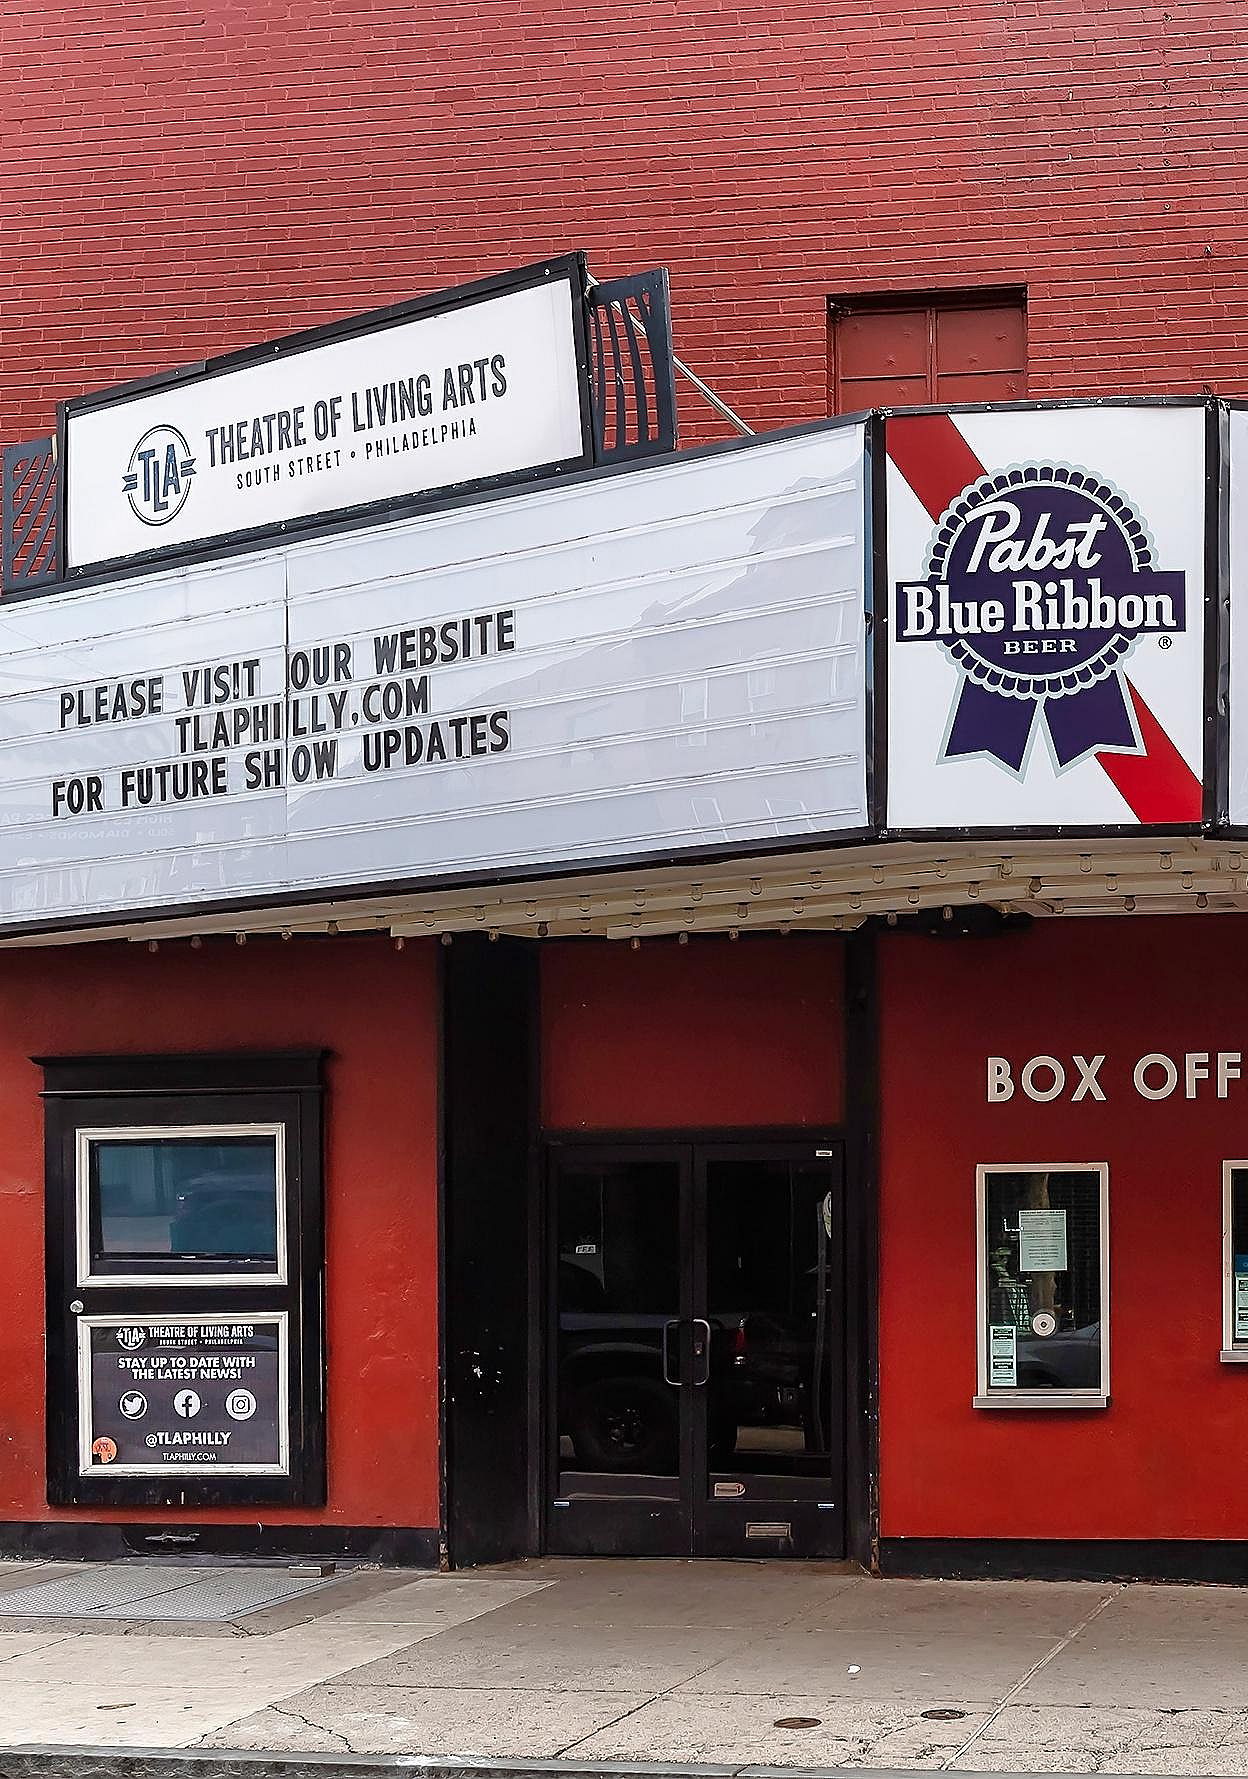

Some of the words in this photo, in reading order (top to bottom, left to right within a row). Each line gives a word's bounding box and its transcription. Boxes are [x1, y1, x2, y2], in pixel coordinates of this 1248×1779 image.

[205, 405, 307, 468] THEATRE
[313, 395, 343, 442] OF
[352, 373, 433, 433] LIVING
[442, 353, 507, 411] ARTS
[137, 443, 181, 513] TLA
[236, 463, 281, 490] SOUTH
[288, 449, 342, 478] STREET
[365, 417, 477, 460] PHILADELPHIA
[963, 500, 1108, 573] Pabst
[902, 584, 1005, 637] Blue
[1012, 577, 1177, 632] Ribbon
[60, 676, 162, 729] PLEASE
[290, 642, 353, 691] OUR
[373, 609, 515, 675] WEBSITE
[1003, 639, 1078, 655] BEER
[52, 775, 104, 817] FOR
[121, 756, 228, 807] FUTURE
[244, 738, 339, 790] SHOW
[362, 710, 509, 772] UPDATES
[987, 1054, 1107, 1102] BOX
[149, 1326, 186, 1338] THEATRE
[186, 1326, 199, 1338] OF
[200, 1325, 230, 1338] LIVING
[230, 1325, 254, 1338] ARTS
[117, 1357, 148, 1369] STAY
[150, 1357, 168, 1369] UP
[169, 1356, 187, 1369] TO
[189, 1356, 220, 1368] DATE
[221, 1356, 256, 1368] WITH
[131, 1368, 155, 1380] THE
[157, 1368, 198, 1380] LATEST
[199, 1367, 242, 1380] NEWS!
[145, 1431, 232, 1448] @TLAPHILLY
[162, 1452, 217, 1461] TLAPHILLY.COM
